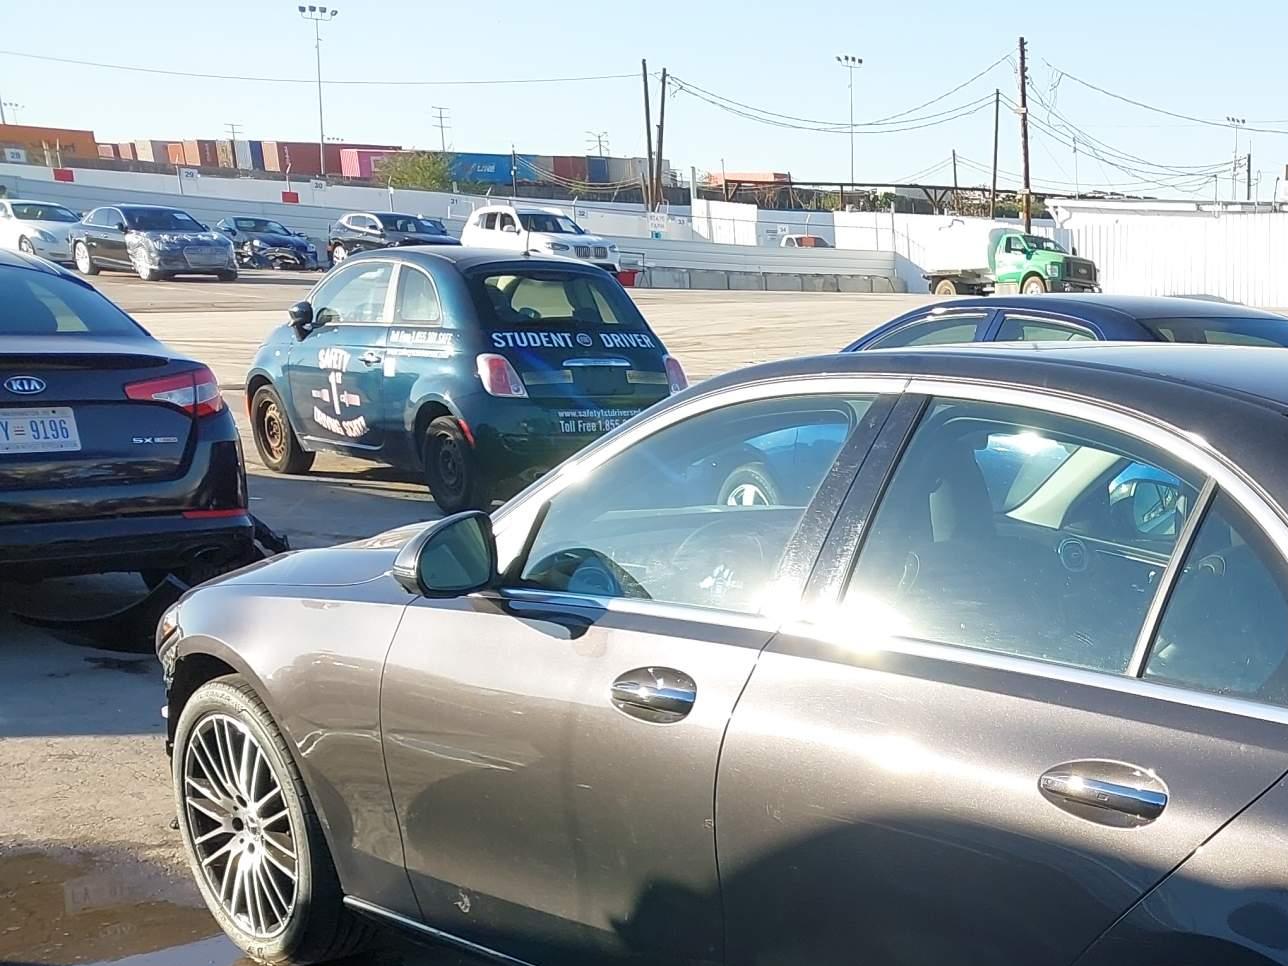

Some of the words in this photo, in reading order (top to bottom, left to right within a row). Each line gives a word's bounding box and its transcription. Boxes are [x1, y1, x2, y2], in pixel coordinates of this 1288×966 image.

[491, 332, 574, 348] STUDENT
[600, 333, 656, 349] DRIVER
[319, 347, 351, 373] SAFETY
[11, 380, 41, 391] KIA
[30, 419, 69, 440] 9196
[559, 420, 576, 433] Toll
[578, 420, 597, 432] Free
